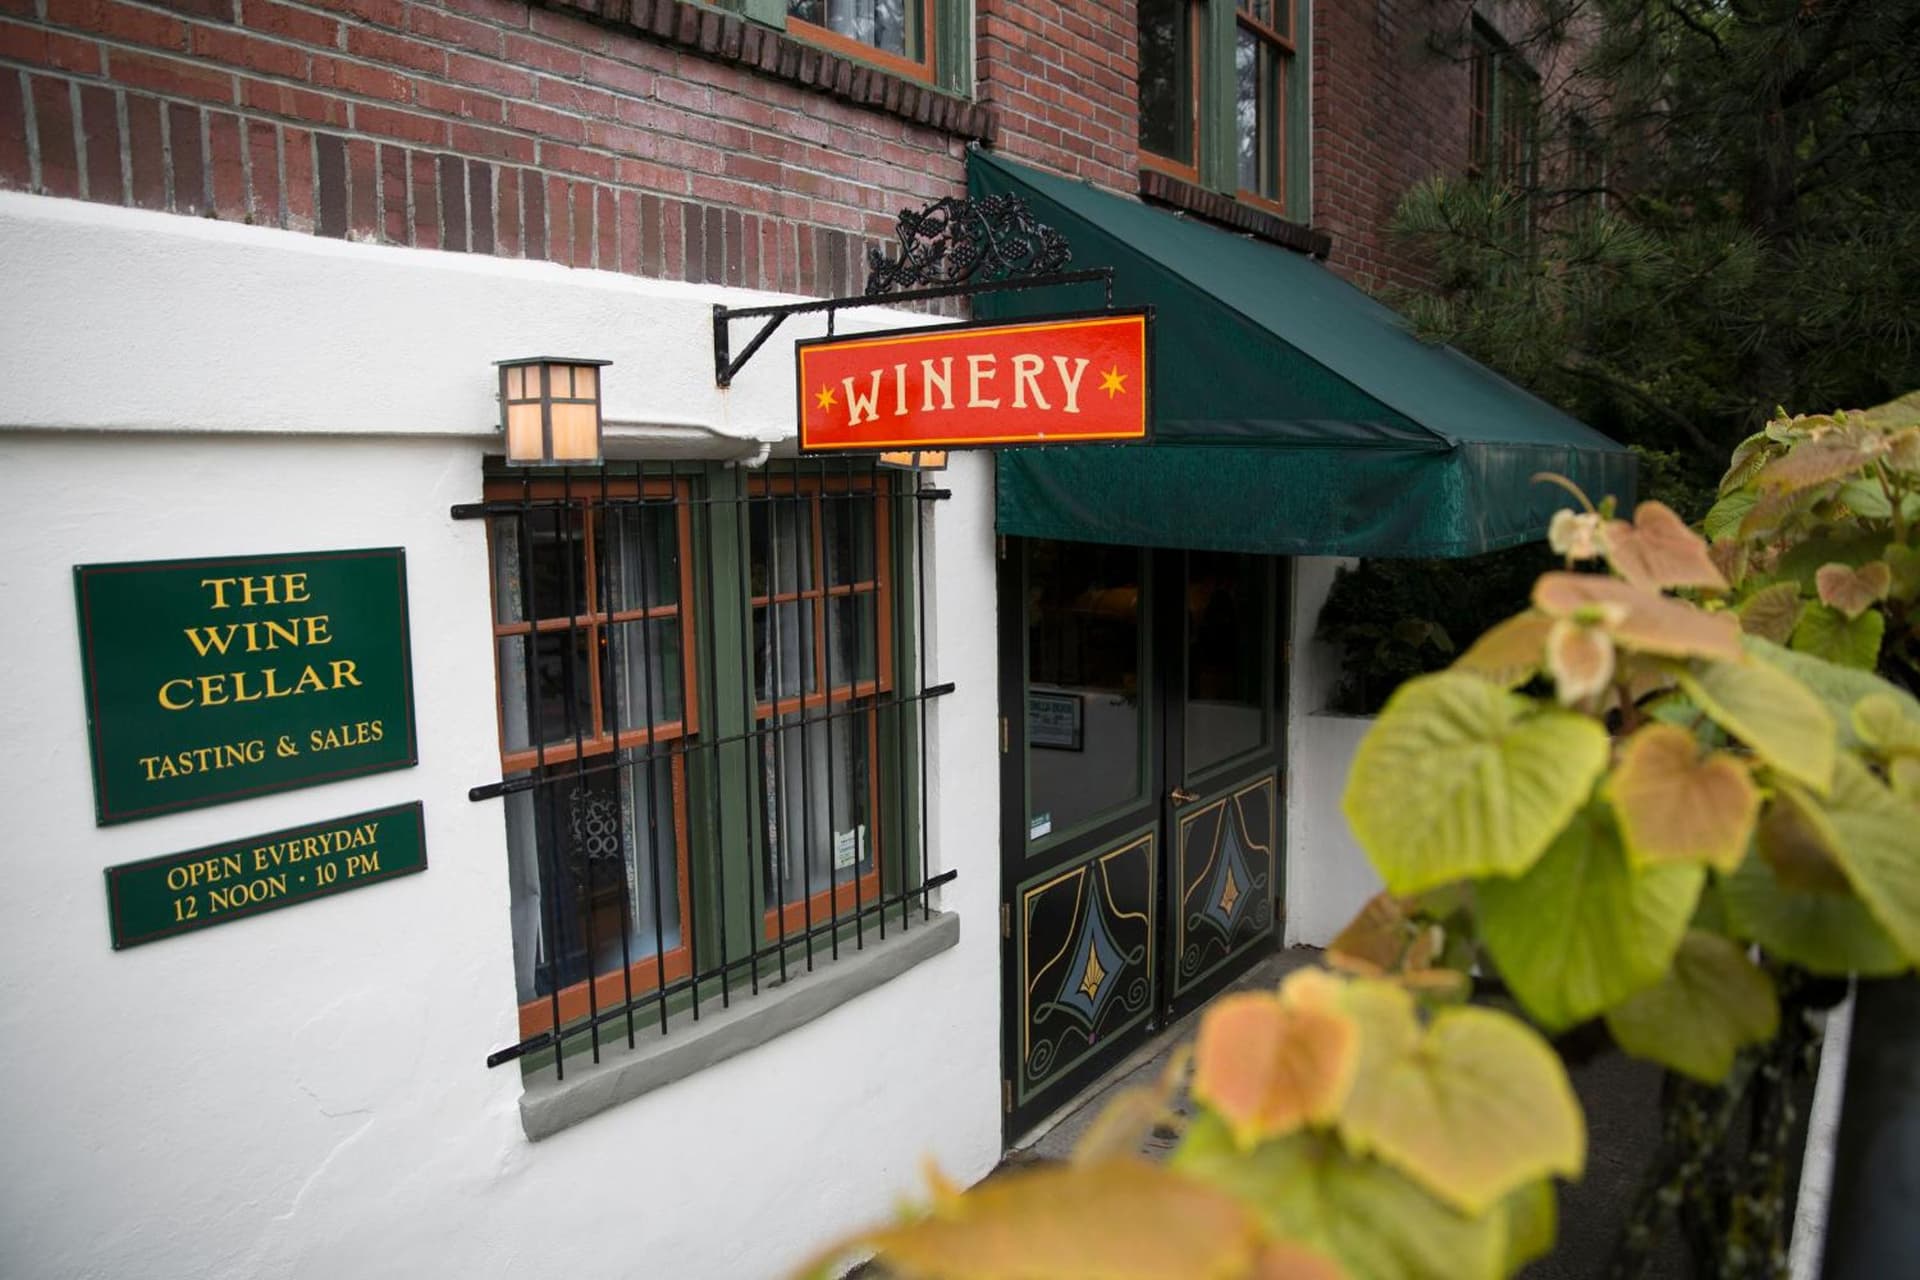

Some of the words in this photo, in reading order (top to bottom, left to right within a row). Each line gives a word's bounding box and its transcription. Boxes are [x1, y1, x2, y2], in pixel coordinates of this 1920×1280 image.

[842, 353, 1090, 427] WINERY
[201, 572, 311, 609] THE
[184, 615, 333, 657] WINE
[158, 659, 363, 711] CELLAR
[140, 740, 265, 781] TASTING
[276, 735, 299, 758] &
[310, 720, 384, 752] SALES
[166, 853, 242, 892] OPEN
[253, 823, 381, 869] EVERYDAY
[173, 895, 198, 922] 12
[209, 874, 287, 914] NOON
[315, 863, 337, 887] 10
[347, 850, 381, 878] PM
